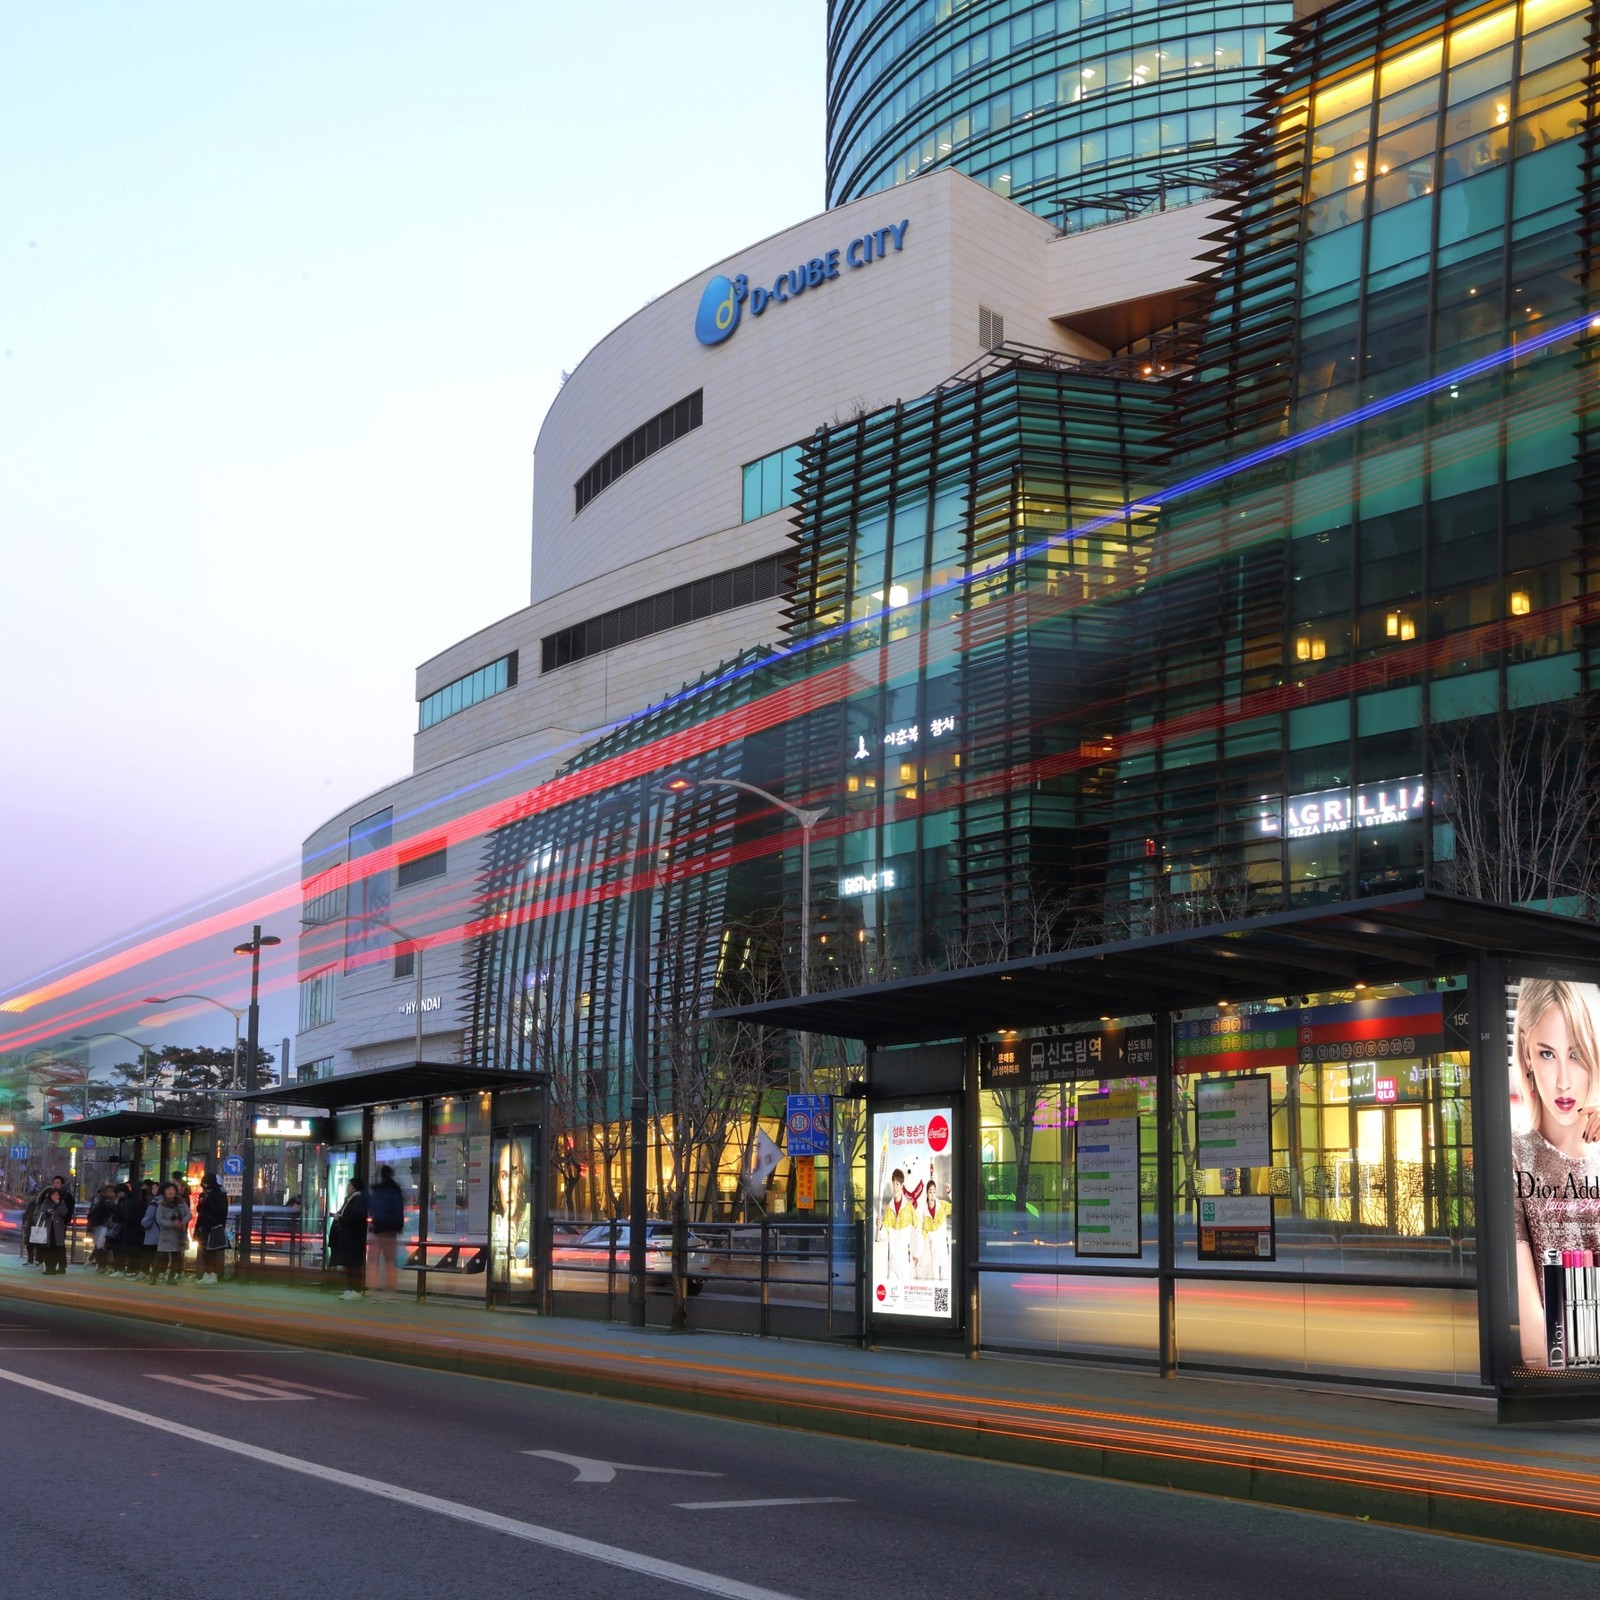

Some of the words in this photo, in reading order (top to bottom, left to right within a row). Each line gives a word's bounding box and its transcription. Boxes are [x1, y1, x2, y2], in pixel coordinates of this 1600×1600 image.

[750, 249, 840, 316] D-CUBE
[846, 219, 909, 268] CITY
[884, 726, 919, 746] 이춘복
[930, 715, 955, 737] 참치
[1365, 810, 1408, 827] STEAK
[1047, 1037, 1102, 1065] 신도림역
[1127, 1051, 1153, 1064] (구로역)
[1053, 1069, 1075, 1079] Sindorim
[1075, 1067, 1095, 1077] Station
[1377, 1079, 1393, 1090] UNI
[1378, 1089, 1395, 1100] QLO
[892, 1126, 905, 1138] 성화
[906, 1124, 926, 1138] 봉송의
[1515, 1171, 1560, 1199] Dior
[1563, 1172, 1600, 1199] Add
[1203, 1203, 1215, 1215] 83
[1550, 1321, 1564, 1366] Dior
